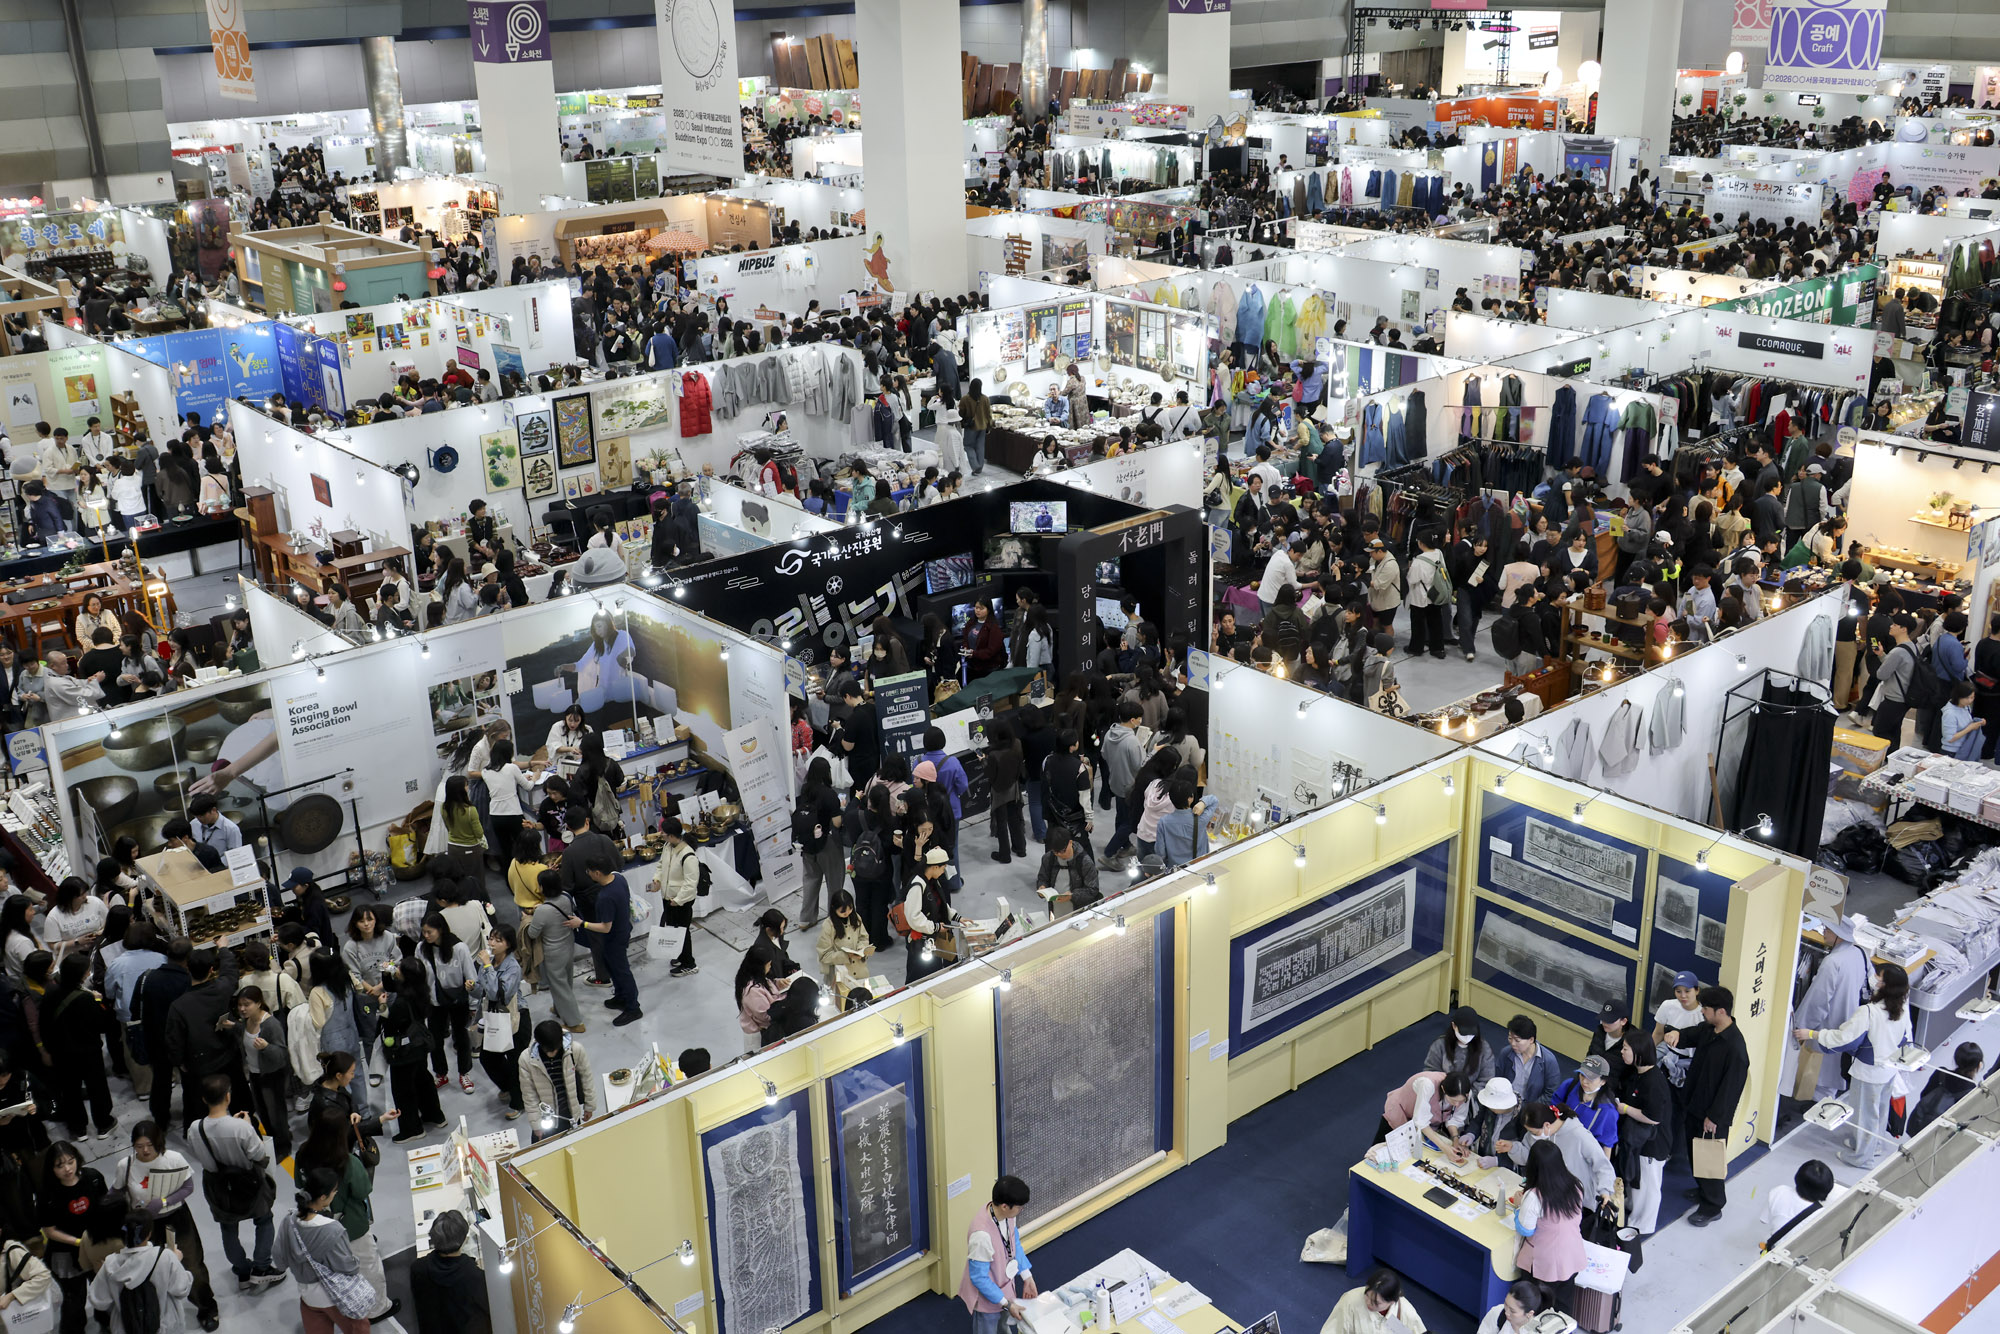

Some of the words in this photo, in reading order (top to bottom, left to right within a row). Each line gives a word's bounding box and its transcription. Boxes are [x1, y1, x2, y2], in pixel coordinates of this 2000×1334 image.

[472, 7, 489, 20] 소화전
[1810, 24, 1840, 42] 공예
[522, 49, 542, 58] 소화전
[1812, 43, 1834, 53] Craft
[1774, 74, 1792, 83] 2026
[1805, 76, 1864, 86] 서울국제불교박람회
[673, 108, 685, 118] 2026
[695, 112, 732, 124] 서울국제불교박람회
[690, 122, 704, 132] Seoul
[704, 124, 733, 136] International
[675, 132, 697, 143] Buddhism
[697, 135, 708, 146] Expo
[720, 138, 734, 148] 2026
[1946, 152, 1966, 161] 승가원
[1728, 180, 1749, 192] 내가
[1752, 182, 1783, 196] 부처가
[20, 218, 106, 249] 함월도예
[738, 255, 775, 273] HIPBUZ
[198, 357, 223, 369] 엄마와
[250, 357, 269, 370] 청년
[201, 374, 225, 385] 행복학교
[251, 366, 275, 377] 행복학교
[1118, 521, 1165, 553] 不老門
[811, 536, 883, 567] 국가유산진흥원
[1081, 584, 1092, 646] 당신의
[288, 702, 320, 716] Korea
[290, 710, 330, 727] Singing
[332, 701, 358, 715] Bowl
[291, 714, 352, 736] Association
[1751, 942, 1767, 994] 스며든
